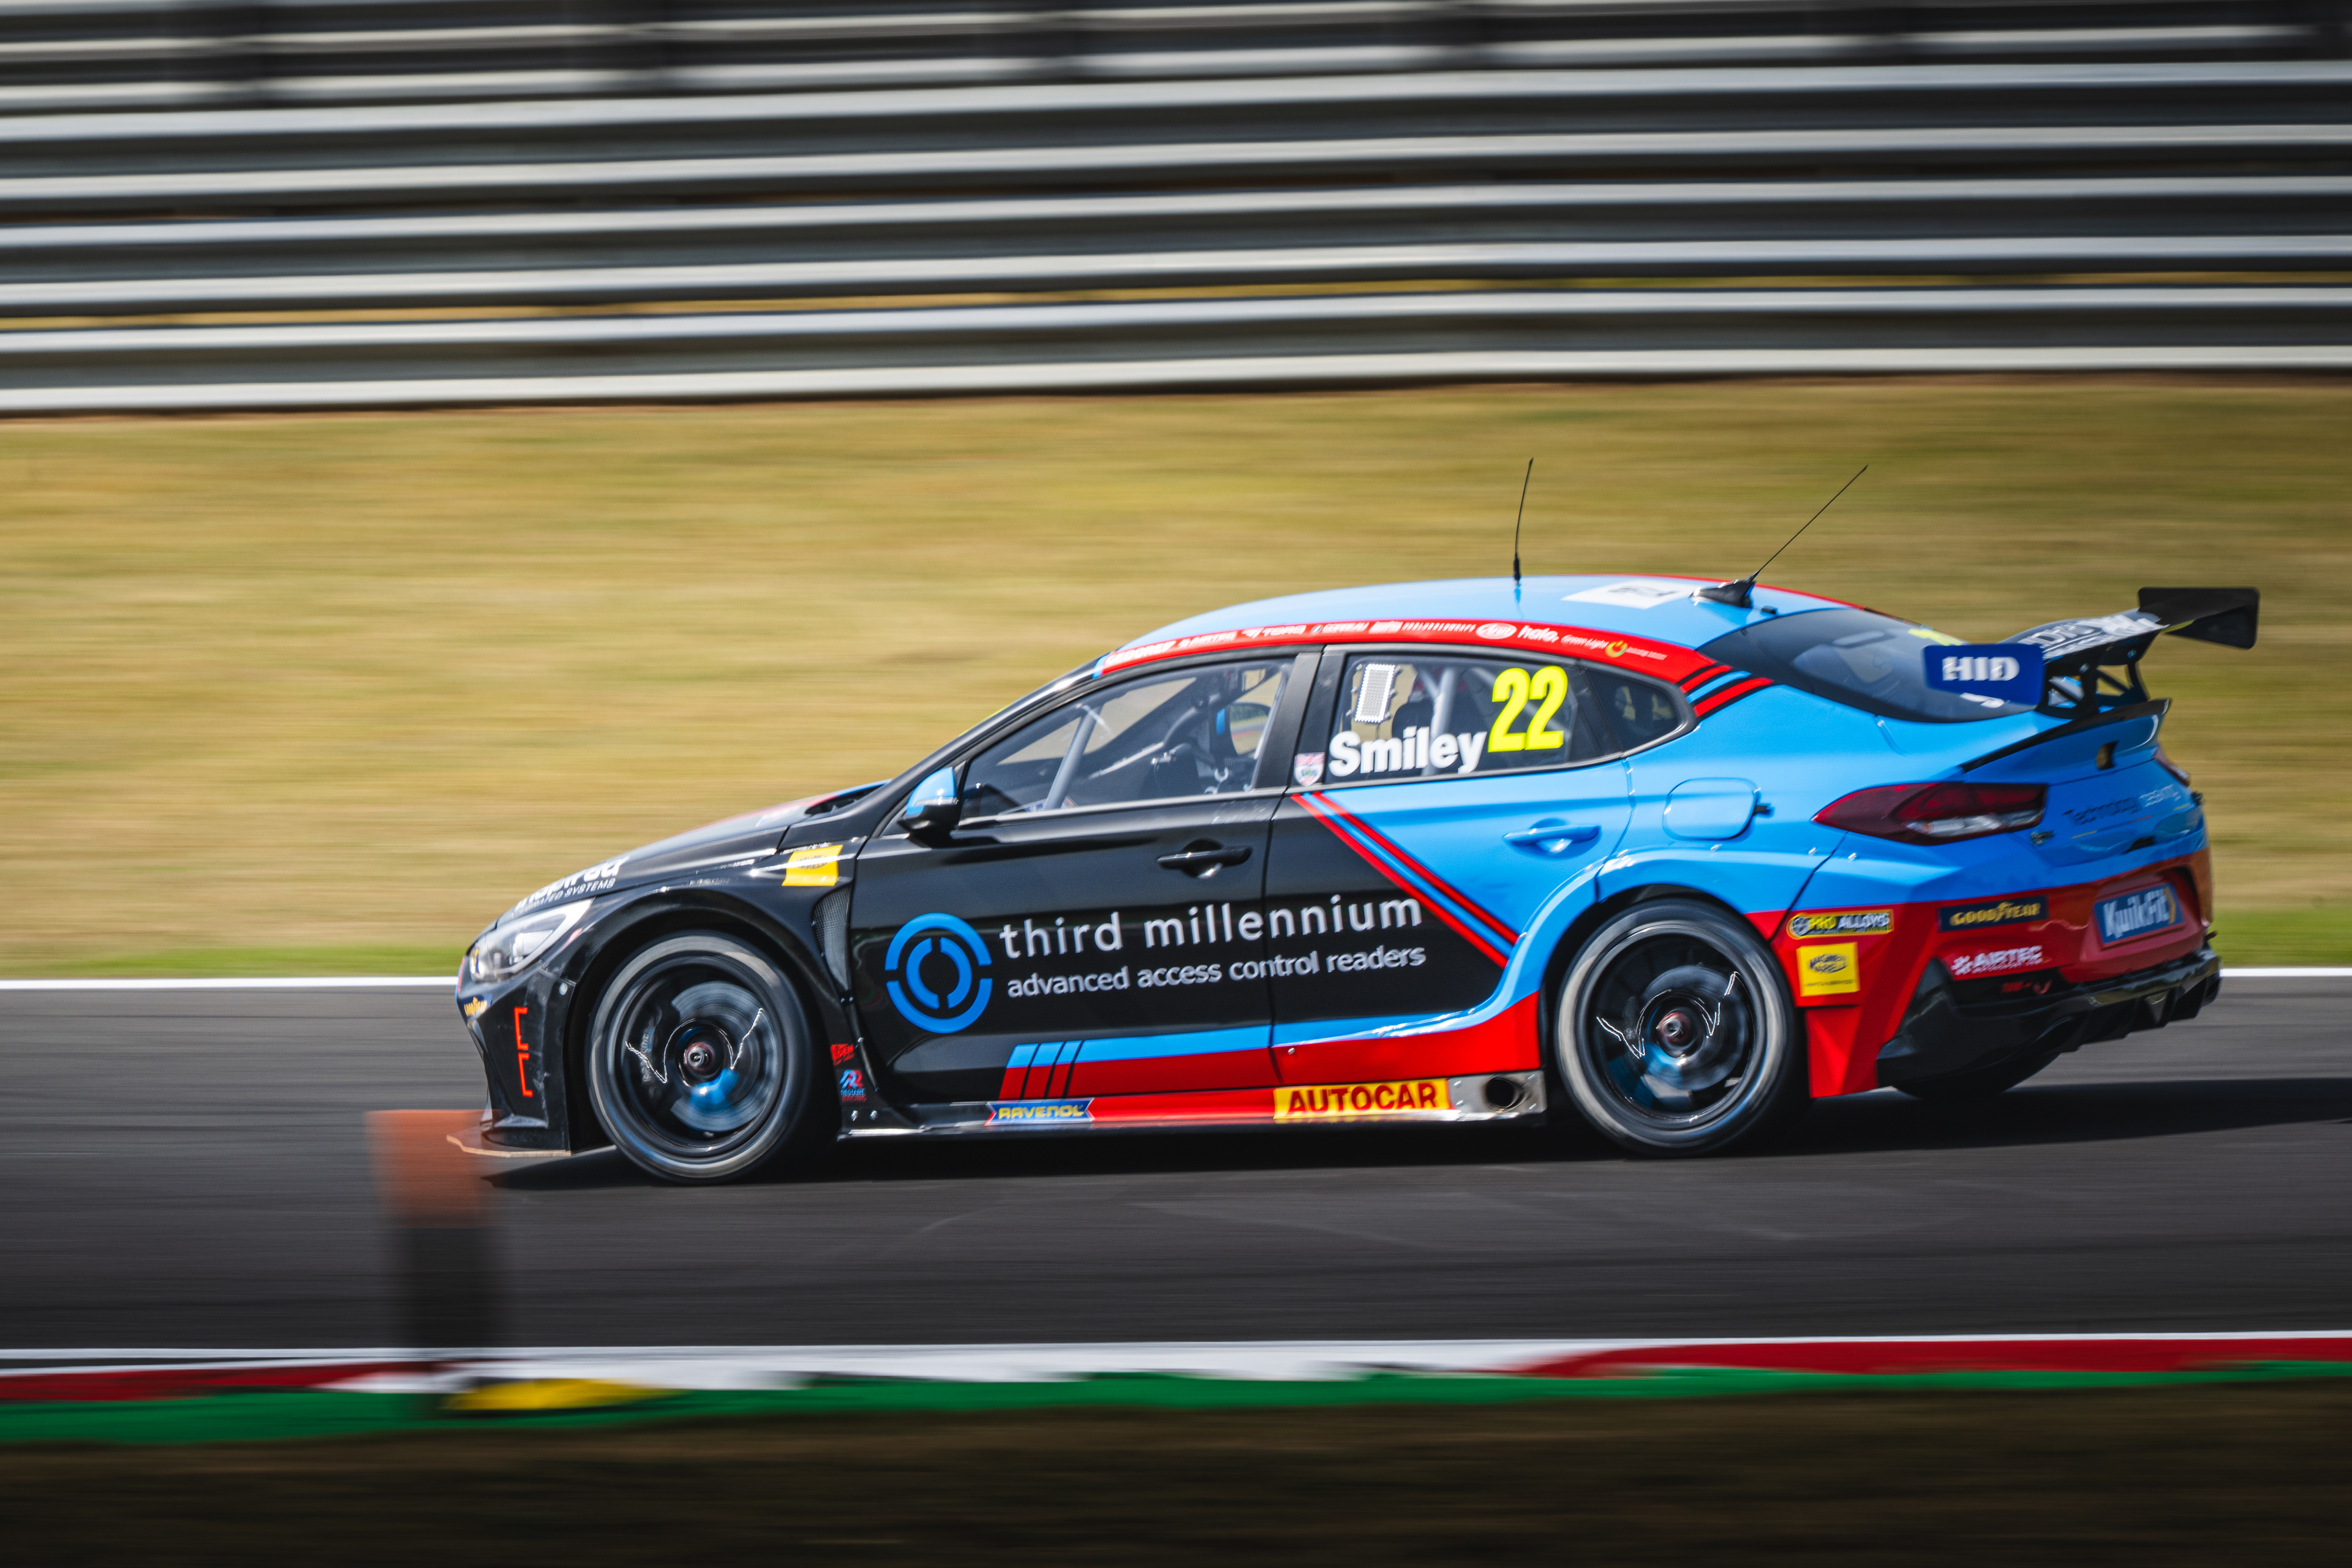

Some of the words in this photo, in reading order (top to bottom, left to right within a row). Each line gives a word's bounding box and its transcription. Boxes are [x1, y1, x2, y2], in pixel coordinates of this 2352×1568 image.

[1942, 657, 2020, 682] HID
[1488, 666, 1568, 752] 22
[1329, 727, 1487, 775] Smiley
[564, 872, 616, 898] SYSTEMS
[1000, 911, 1123, 959] third
[1144, 894, 1422, 948] millennium
[1809, 916, 1836, 930] PRO
[1838, 912, 1890, 929] ALLOYS
[1950, 902, 2041, 926] GOODYEAR
[1972, 945, 2043, 967] AIRTEC
[1008, 965, 1130, 998] advanced
[1137, 963, 1222, 988] access
[1229, 950, 1319, 981] control
[1325, 944, 1427, 973] readers
[1287, 1082, 1437, 1116] AUTOCAR
[998, 1105, 1084, 1120] RAVENOL
